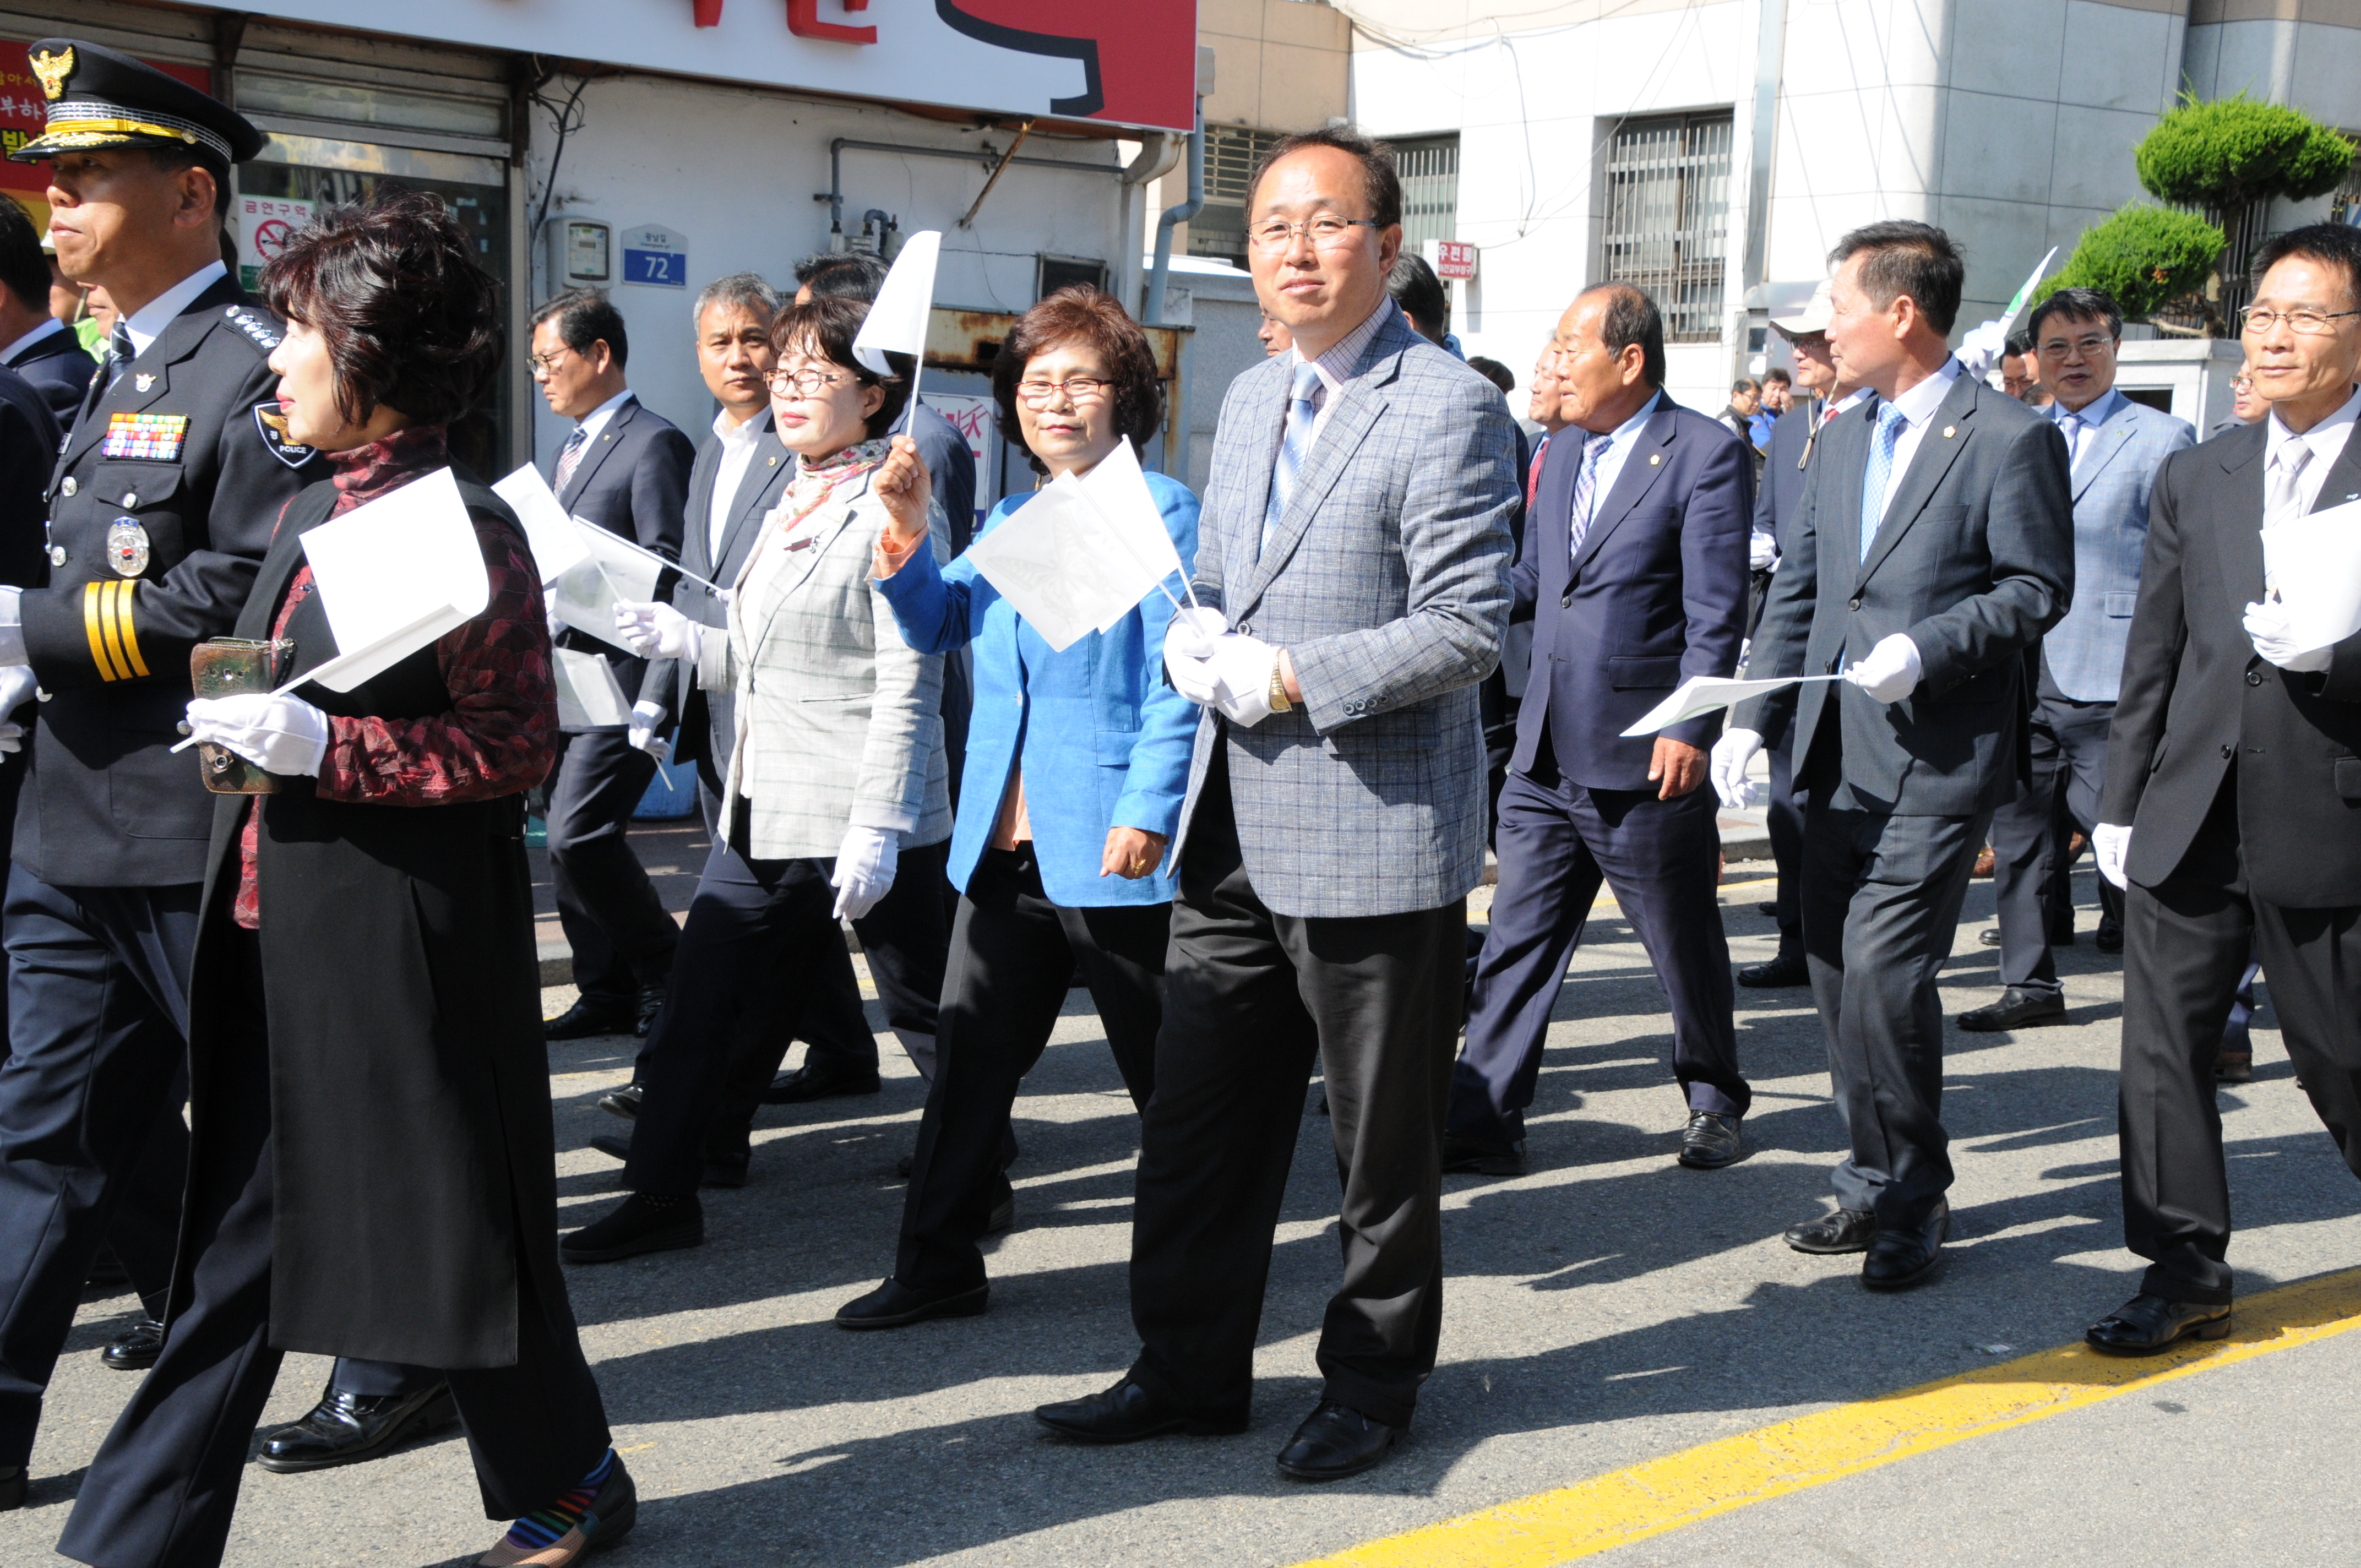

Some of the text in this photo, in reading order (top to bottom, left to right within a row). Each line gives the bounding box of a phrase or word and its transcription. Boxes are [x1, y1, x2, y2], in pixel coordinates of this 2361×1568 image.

[246, 200, 306, 217] 금연구역
[1439, 244, 1472, 262] 우편물
[645, 256, 668, 279] 72
[279, 445, 307, 454] POLICE
